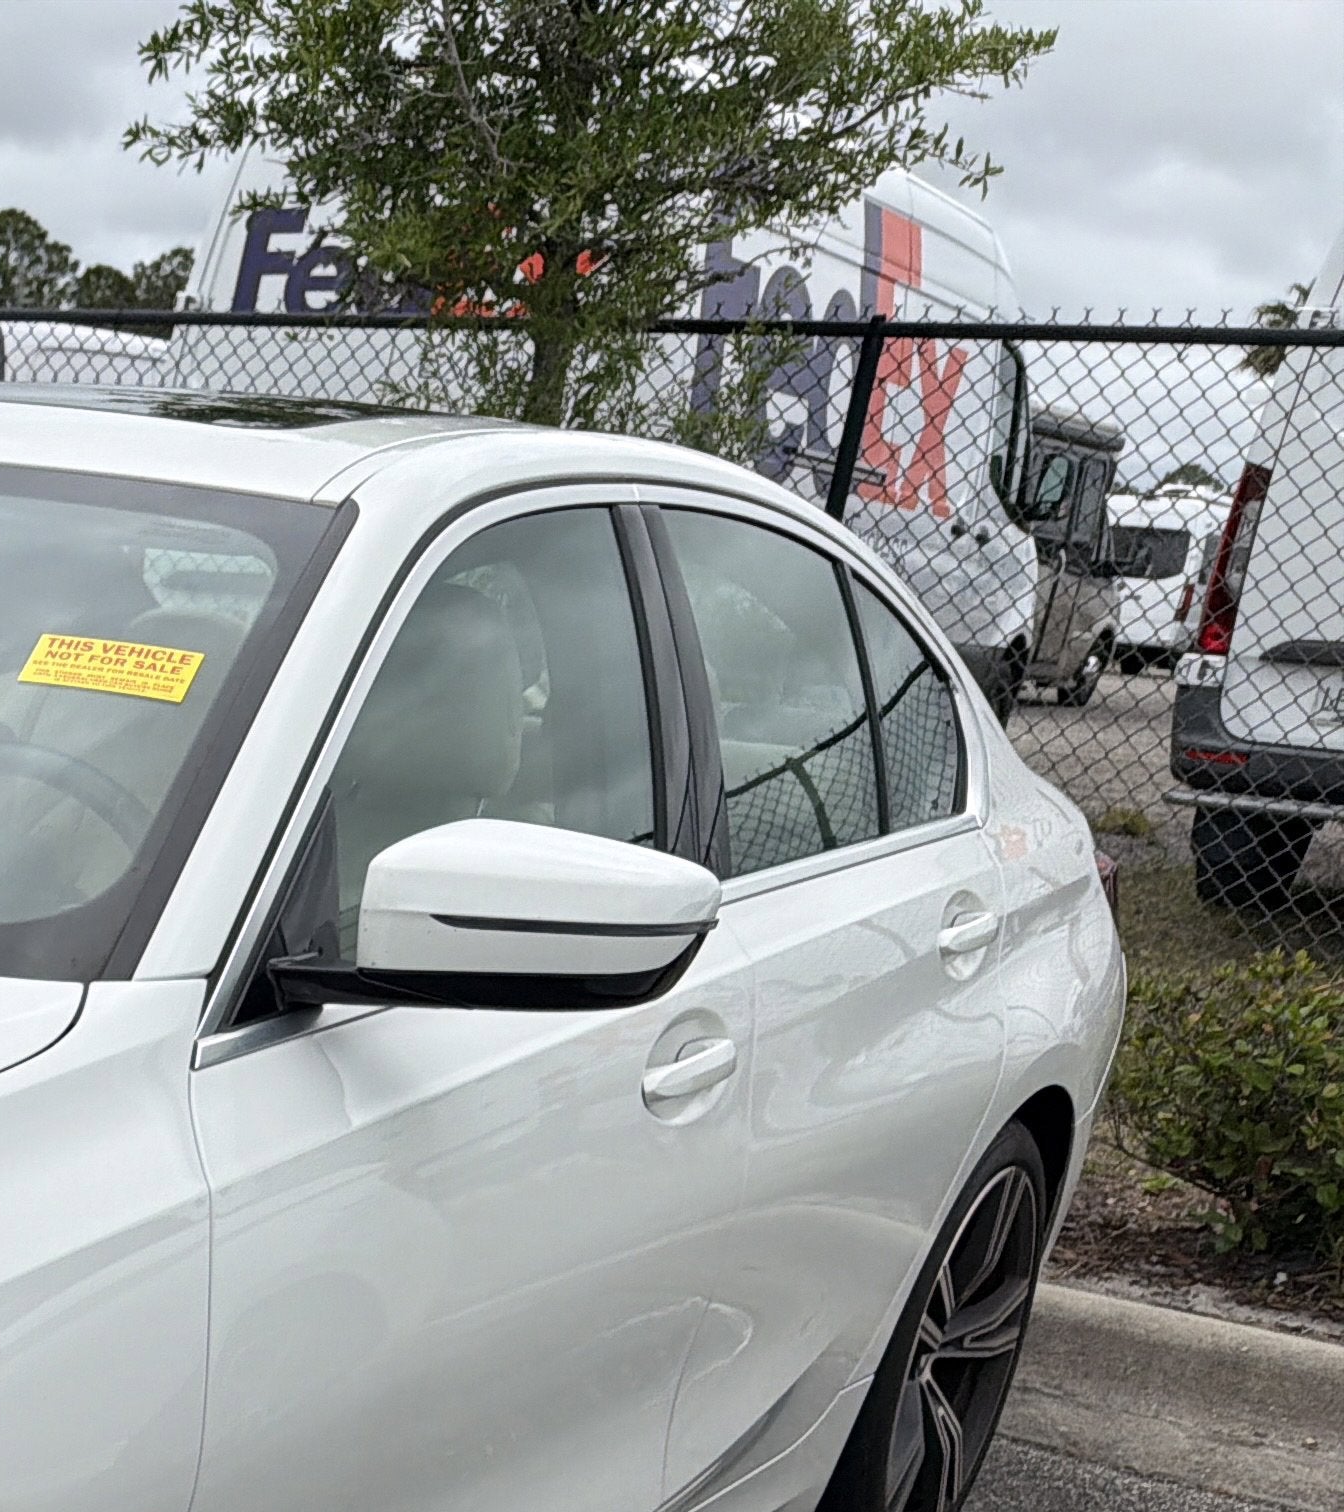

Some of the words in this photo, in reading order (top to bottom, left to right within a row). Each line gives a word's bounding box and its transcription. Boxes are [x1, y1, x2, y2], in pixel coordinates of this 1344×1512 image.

[44, 650, 85, 662] NOT
[88, 655, 128, 669] FOR
[132, 660, 184, 675] SALE
[47, 637, 95, 651] THIS
[102, 643, 195, 666] VEHICLE
[70, 663, 105, 673] DEALER
